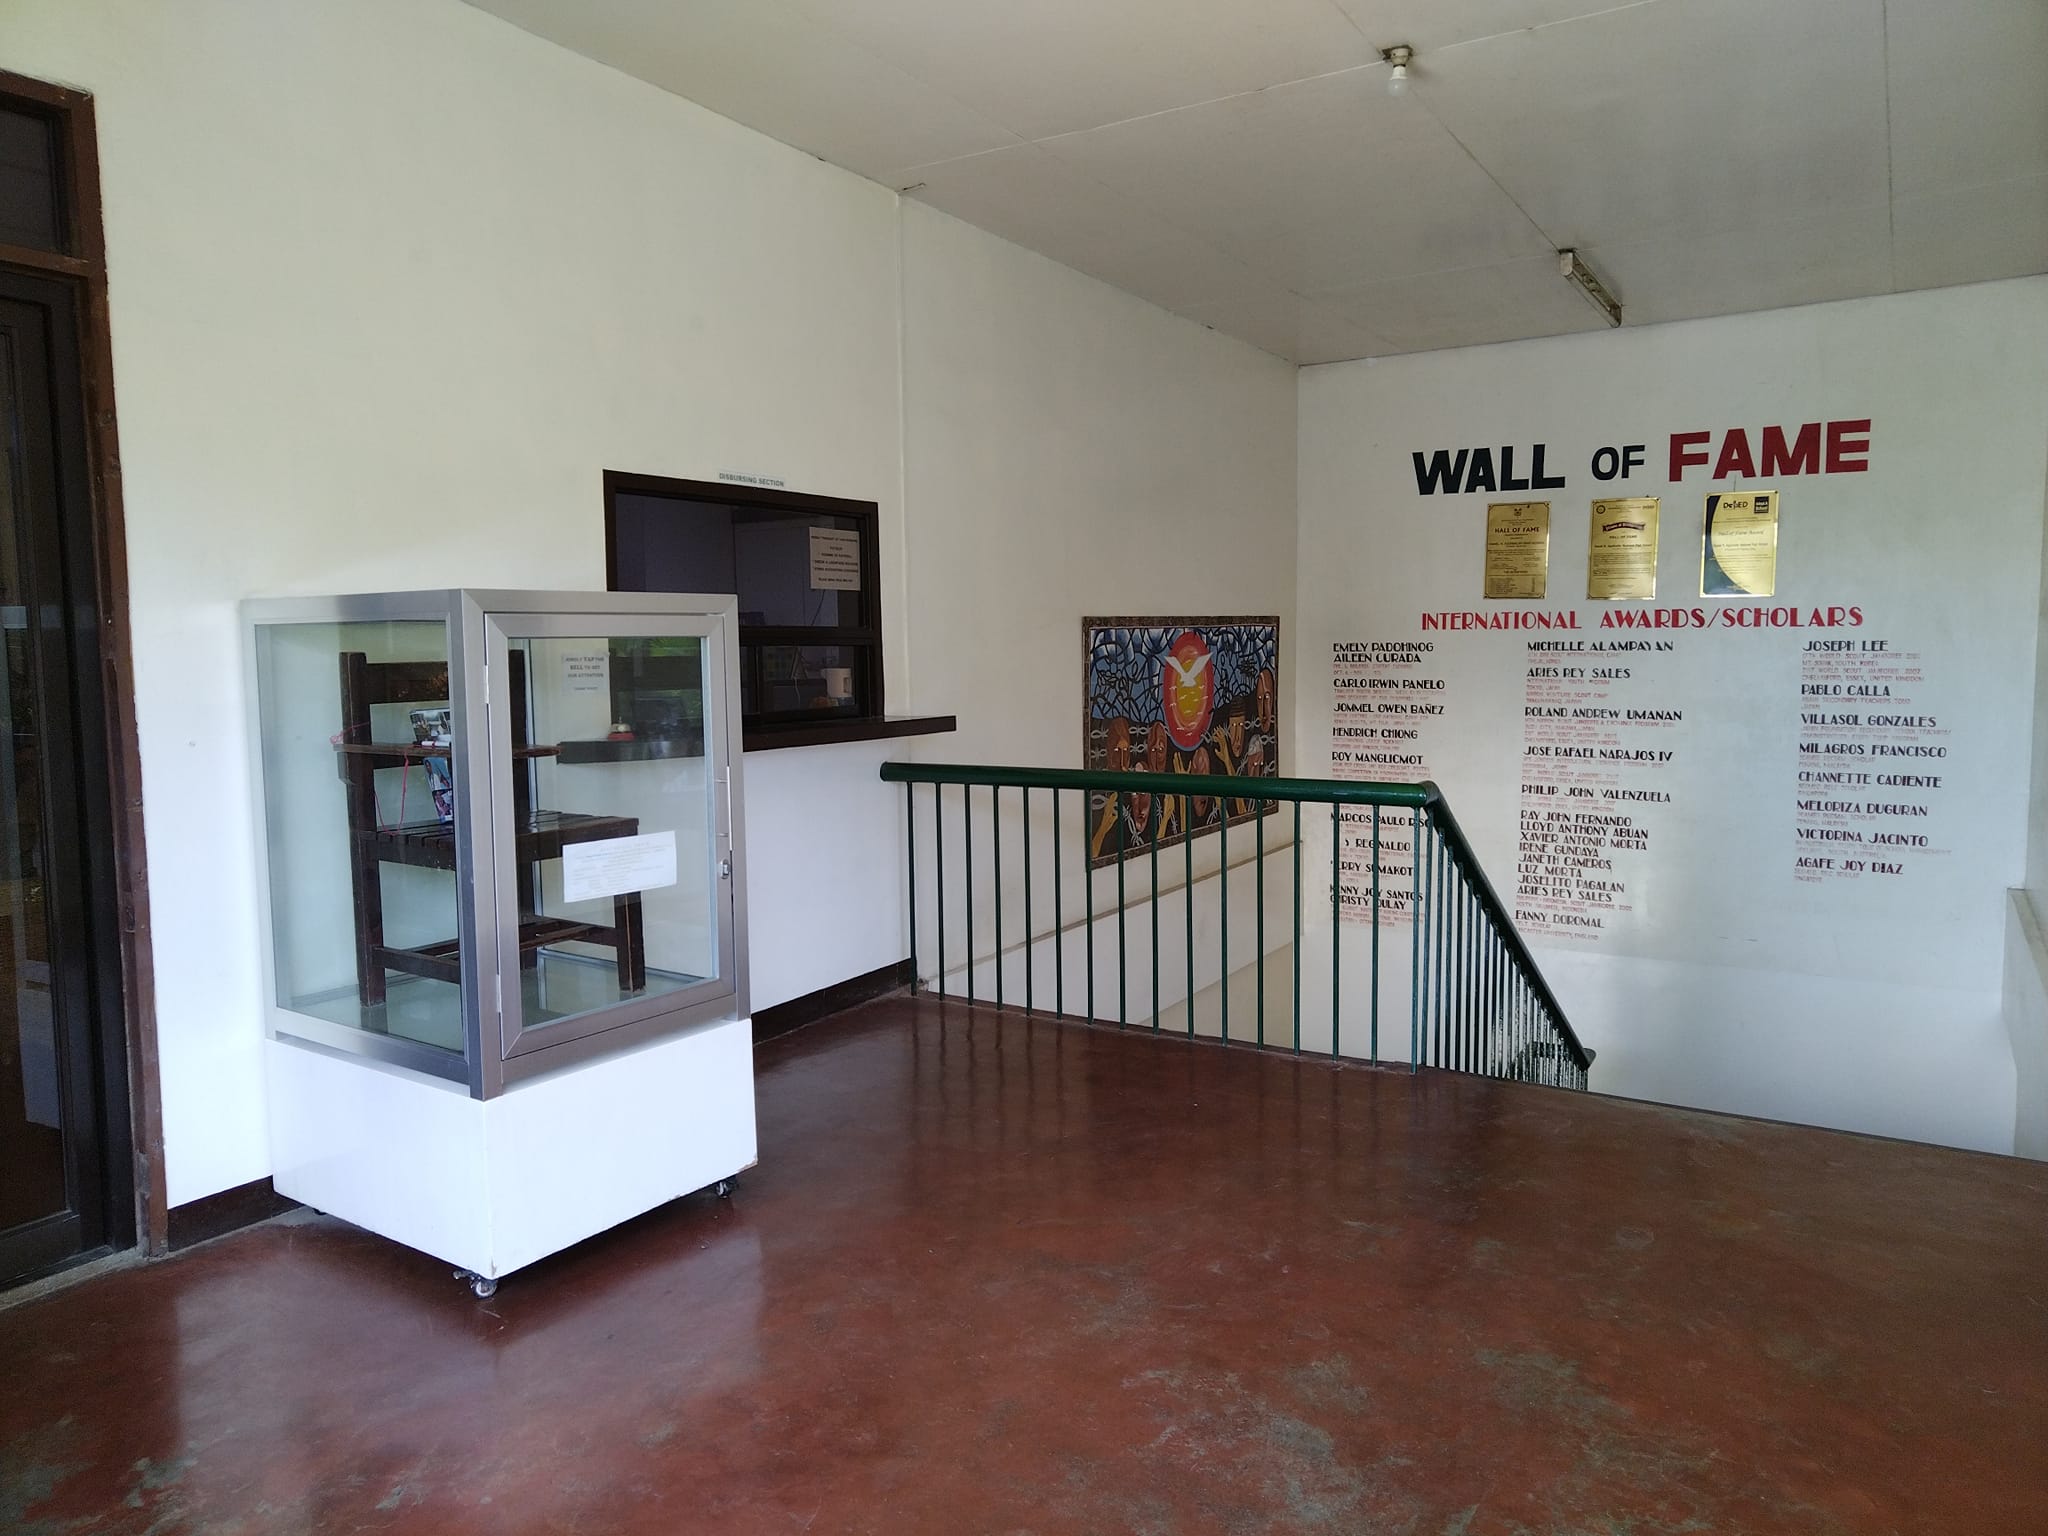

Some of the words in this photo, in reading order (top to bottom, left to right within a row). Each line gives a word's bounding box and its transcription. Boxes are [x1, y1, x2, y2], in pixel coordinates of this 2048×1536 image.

[1412, 444, 1566, 495] WALL
[1591, 444, 1645, 481] OF
[1669, 419, 1871, 482] FAME
[719, 472, 757, 483] DISBURSING
[759, 478, 784, 487] SECTION
[1421, 610, 1582, 631] INTERNATIONAL
[1600, 606, 1864, 630] AWARDS/SCHOLARS
[1333, 642, 1368, 652] EMELY
[1372, 642, 1434, 652] PADOHINOG
[1527, 641, 1584, 651] MICHELLE
[1802, 641, 1855, 651] JOSEPH
[1862, 640, 1888, 651] LEE
[1333, 653, 1372, 662] AILEEN
[1376, 653, 1421, 662] CURADA
[1526, 668, 1558, 677] ARIES
[1563, 668, 1586, 678] REY
[1592, 668, 1631, 679] SALES
[1402, 680, 1445, 689] PANELO
[1801, 684, 1842, 695] PABLO
[1847, 685, 1890, 696] CALLA
[1333, 703, 1374, 713] JOMMEL
[1378, 704, 1407, 714] OWEN
[1410, 703, 1444, 714] BAÑEZ
[1525, 707, 1568, 717] ROLAND
[1572, 708, 1621, 719] ANDREW
[1627, 709, 1682, 721] UMANAN
[1801, 713, 1863, 725] VILLASOL
[1867, 715, 1937, 727] GONZALES
[1381, 729, 1418, 739] CHIONG
[1332, 752, 1352, 761] ROY
[1523, 746, 1552, 756] JOSE
[1555, 747, 1596, 758] RAFAEL
[1599, 749, 1654, 761] NARAJOS
[1658, 751, 1673, 761] IV
[1799, 743, 1865, 755] MILAGROS
[1871, 745, 1947, 758] FRANCISCO
[1798, 771, 1871, 784] CHANNETTE
[1877, 774, 1942, 788] CADIENTE
[1521, 784, 1559, 795] PHILIP
[1564, 787, 1594, 798] JOHN
[1600, 789, 1671, 803] VALENZUELA
[1797, 800, 1861, 813] MELORIZA
[1867, 803, 1928, 816] DUGURAN
[1520, 810, 1540, 821] RAY
[1542, 811, 1570, 822] JOHN
[1575, 813, 1631, 827] FERNANDO
[1520, 821, 1554, 832] LLOYD
[1558, 824, 1608, 836] ANTHONY
[1613, 828, 1648, 839] ABUAN
[1796, 828, 1862, 842] VICTORINA
[1868, 833, 1929, 847] JACINTO
[1520, 831, 1559, 843] XAVIER
[1563, 835, 1607, 847] ANTONIO
[1610, 839, 1647, 851] MORTA
[1519, 842, 1548, 853] IRENE
[1554, 845, 1599, 858] GUNDAYA
[1518, 853, 1559, 865] JANETH
[1564, 856, 1612, 870] CAMEROS
[1796, 857, 1835, 870] AGAFE
[1840, 860, 1867, 872] JOY
[1872, 862, 1903, 875] DIAZ
[1518, 863, 1538, 875] LUZ
[1544, 866, 1582, 878] MORTA
[1517, 874, 1571, 888] JOSELITO
[1517, 885, 1548, 896] ARIES
[1552, 888, 1573, 899] REY
[1578, 890, 1612, 902] SALES
[1515, 910, 1548, 922] FANNY
